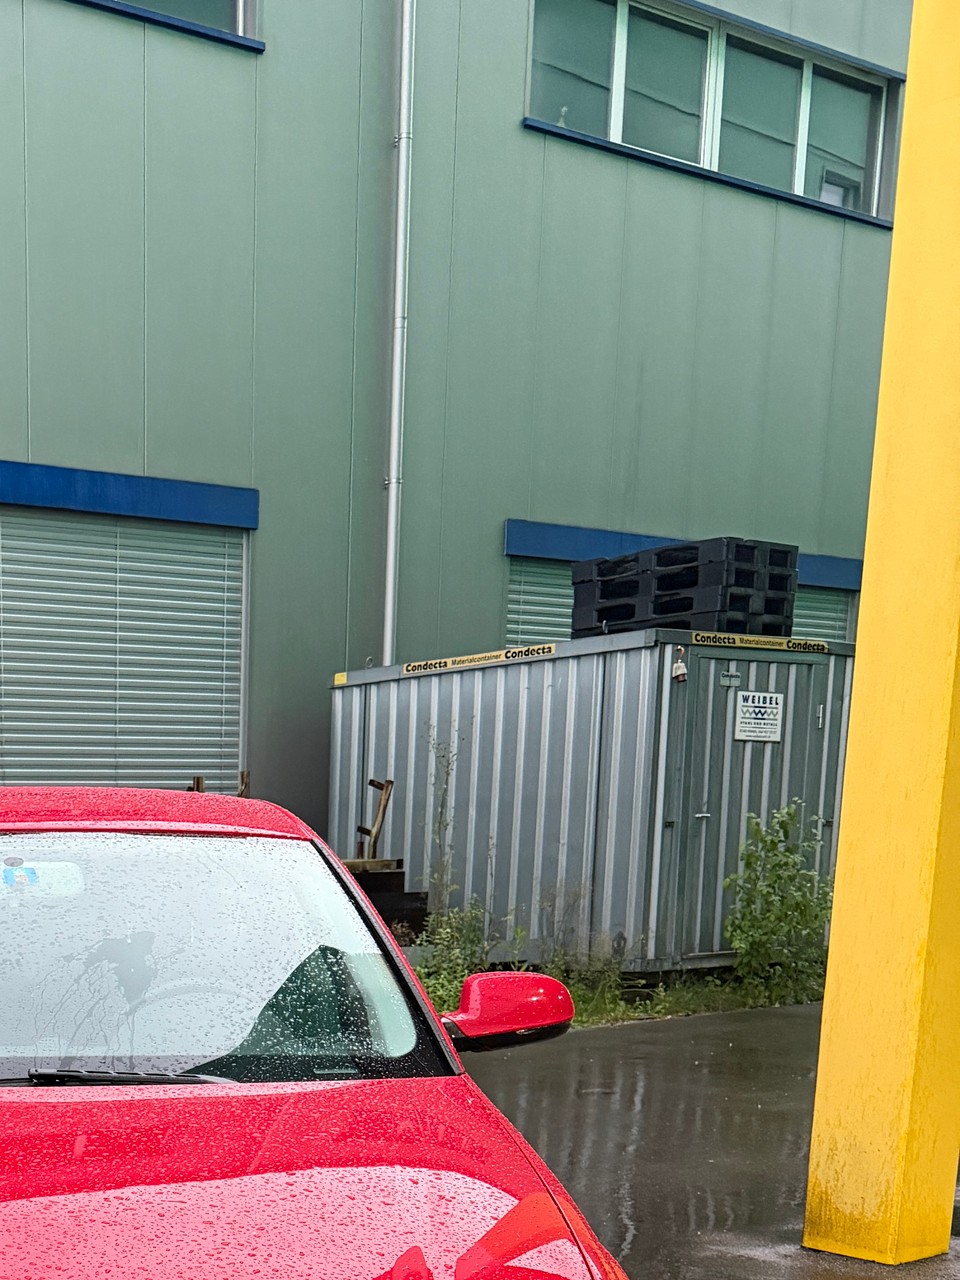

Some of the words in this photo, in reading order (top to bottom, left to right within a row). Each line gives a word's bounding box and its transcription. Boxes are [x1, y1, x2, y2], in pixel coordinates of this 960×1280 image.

[694, 633, 736, 645] Condecta
[739, 637, 784, 648] Materialcontainer
[786, 640, 826, 652] Condecta
[405, 660, 448, 673] Condecta
[451, 653, 502, 666] Materialcontainer
[504, 645, 552, 660] Condecta
[742, 694, 779, 706] WEIBEL
